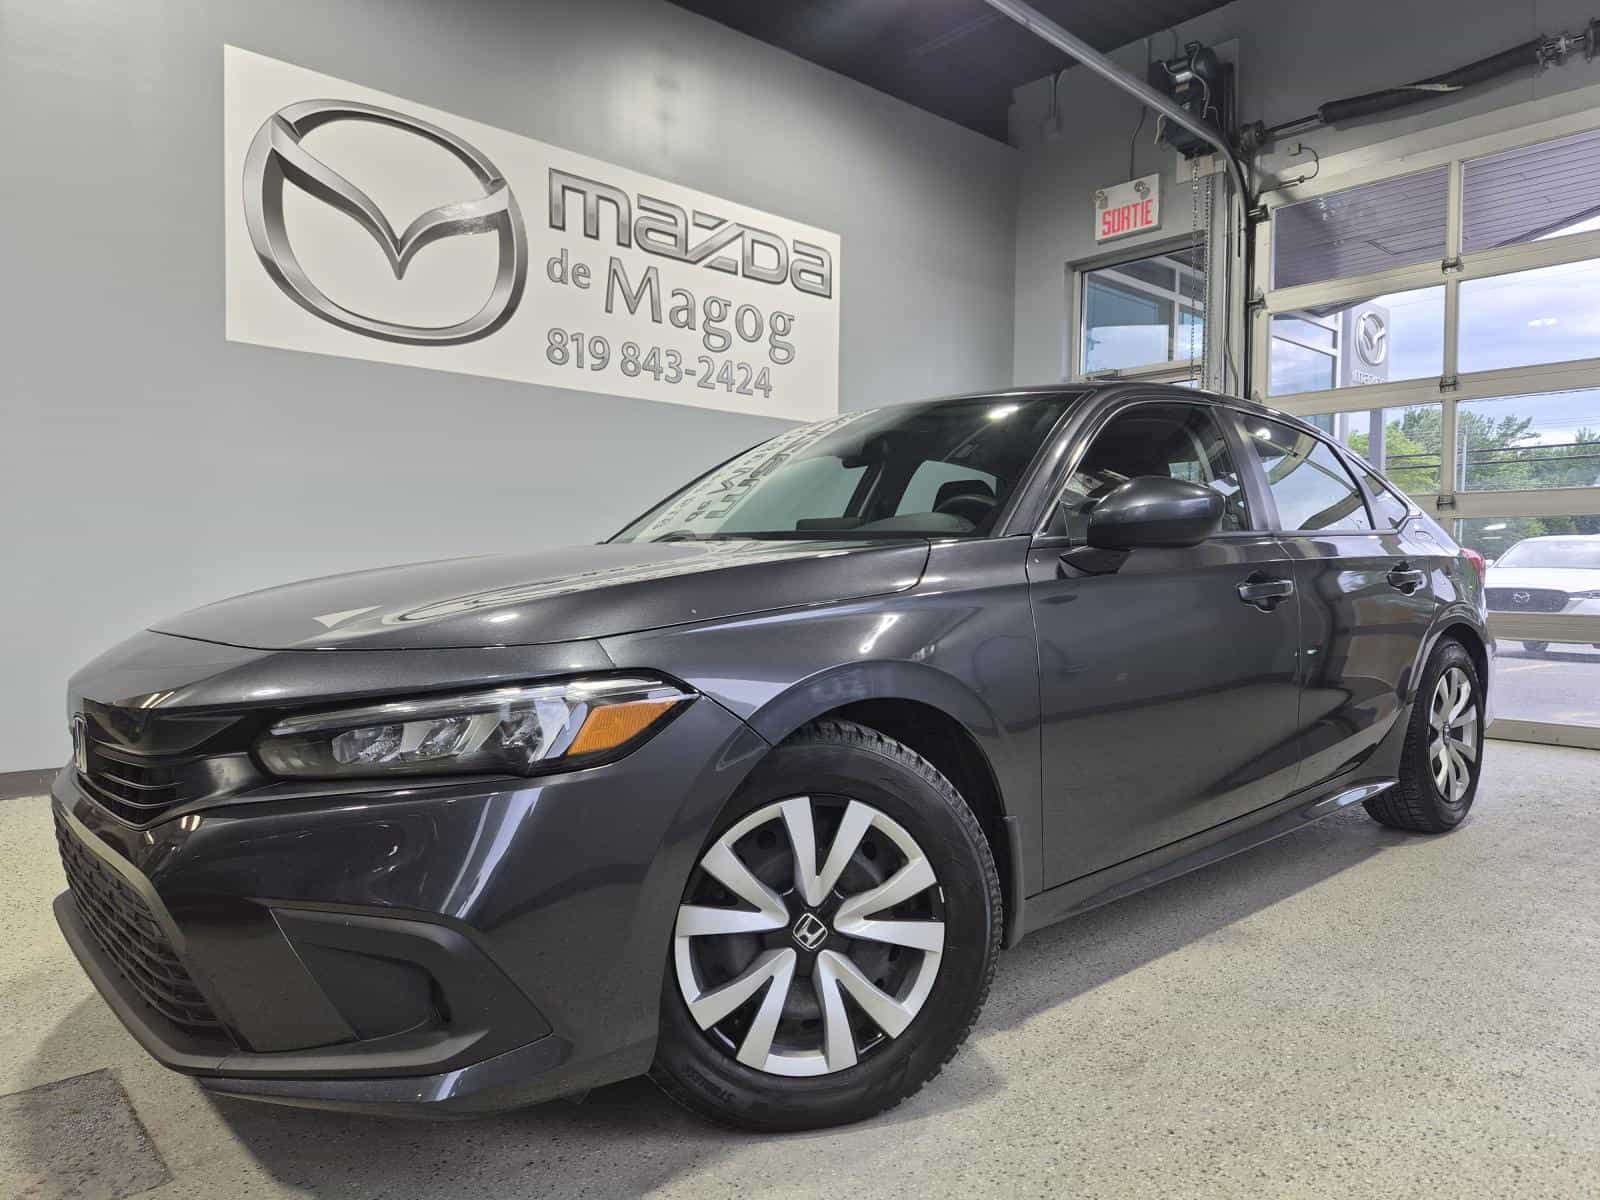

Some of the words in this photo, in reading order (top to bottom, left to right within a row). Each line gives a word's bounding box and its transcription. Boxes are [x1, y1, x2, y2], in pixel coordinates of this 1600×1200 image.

[1103, 199, 1153, 237] SORTIE
[547, 248, 591, 289] de
[605, 256, 795, 365] Magog
[546, 328, 610, 371] 819
[621, 342, 772, 398] 843-2424
